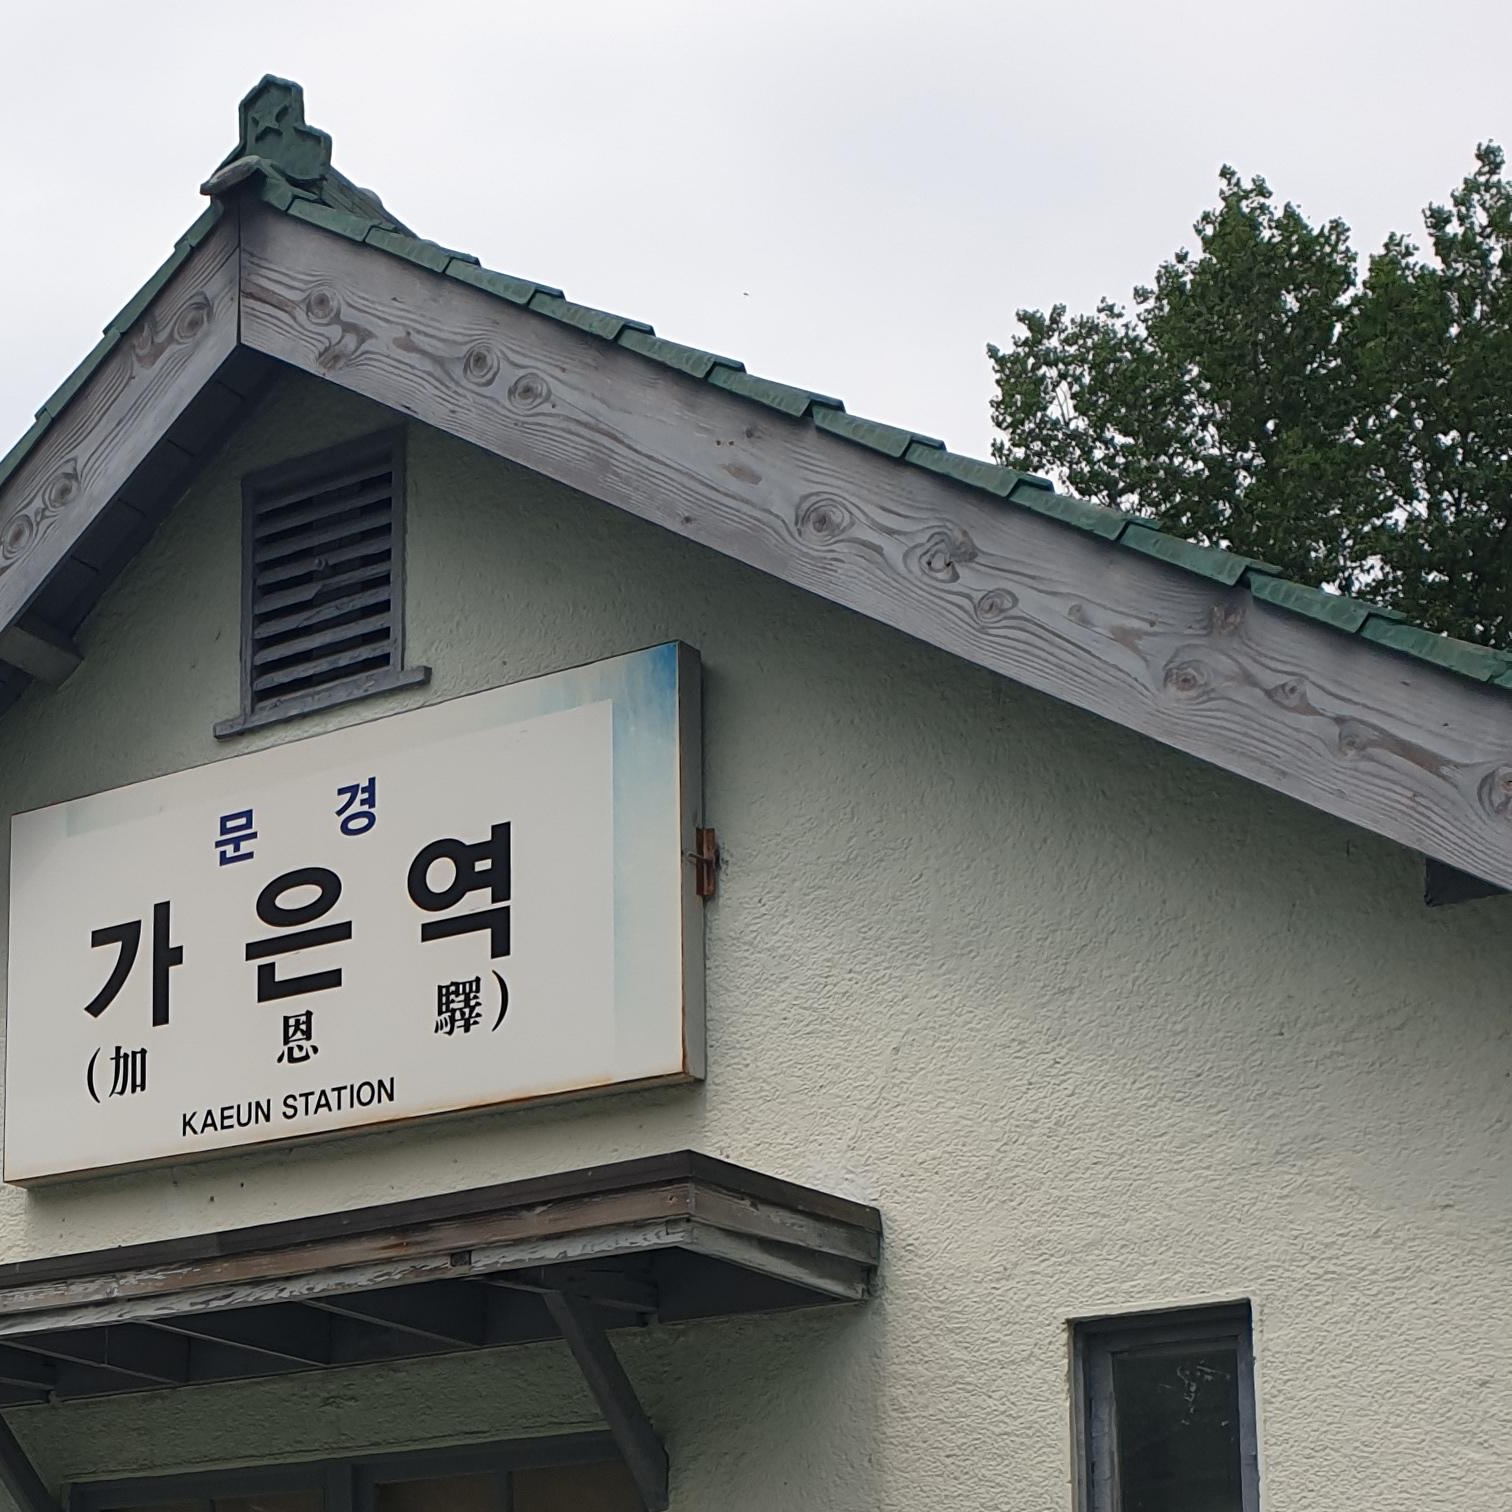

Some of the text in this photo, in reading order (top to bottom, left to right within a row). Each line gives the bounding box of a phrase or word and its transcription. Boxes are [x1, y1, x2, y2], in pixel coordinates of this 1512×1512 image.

[84, 821, 513, 1028] 가은역
[181, 1076, 397, 1138] KAEUN STATION
